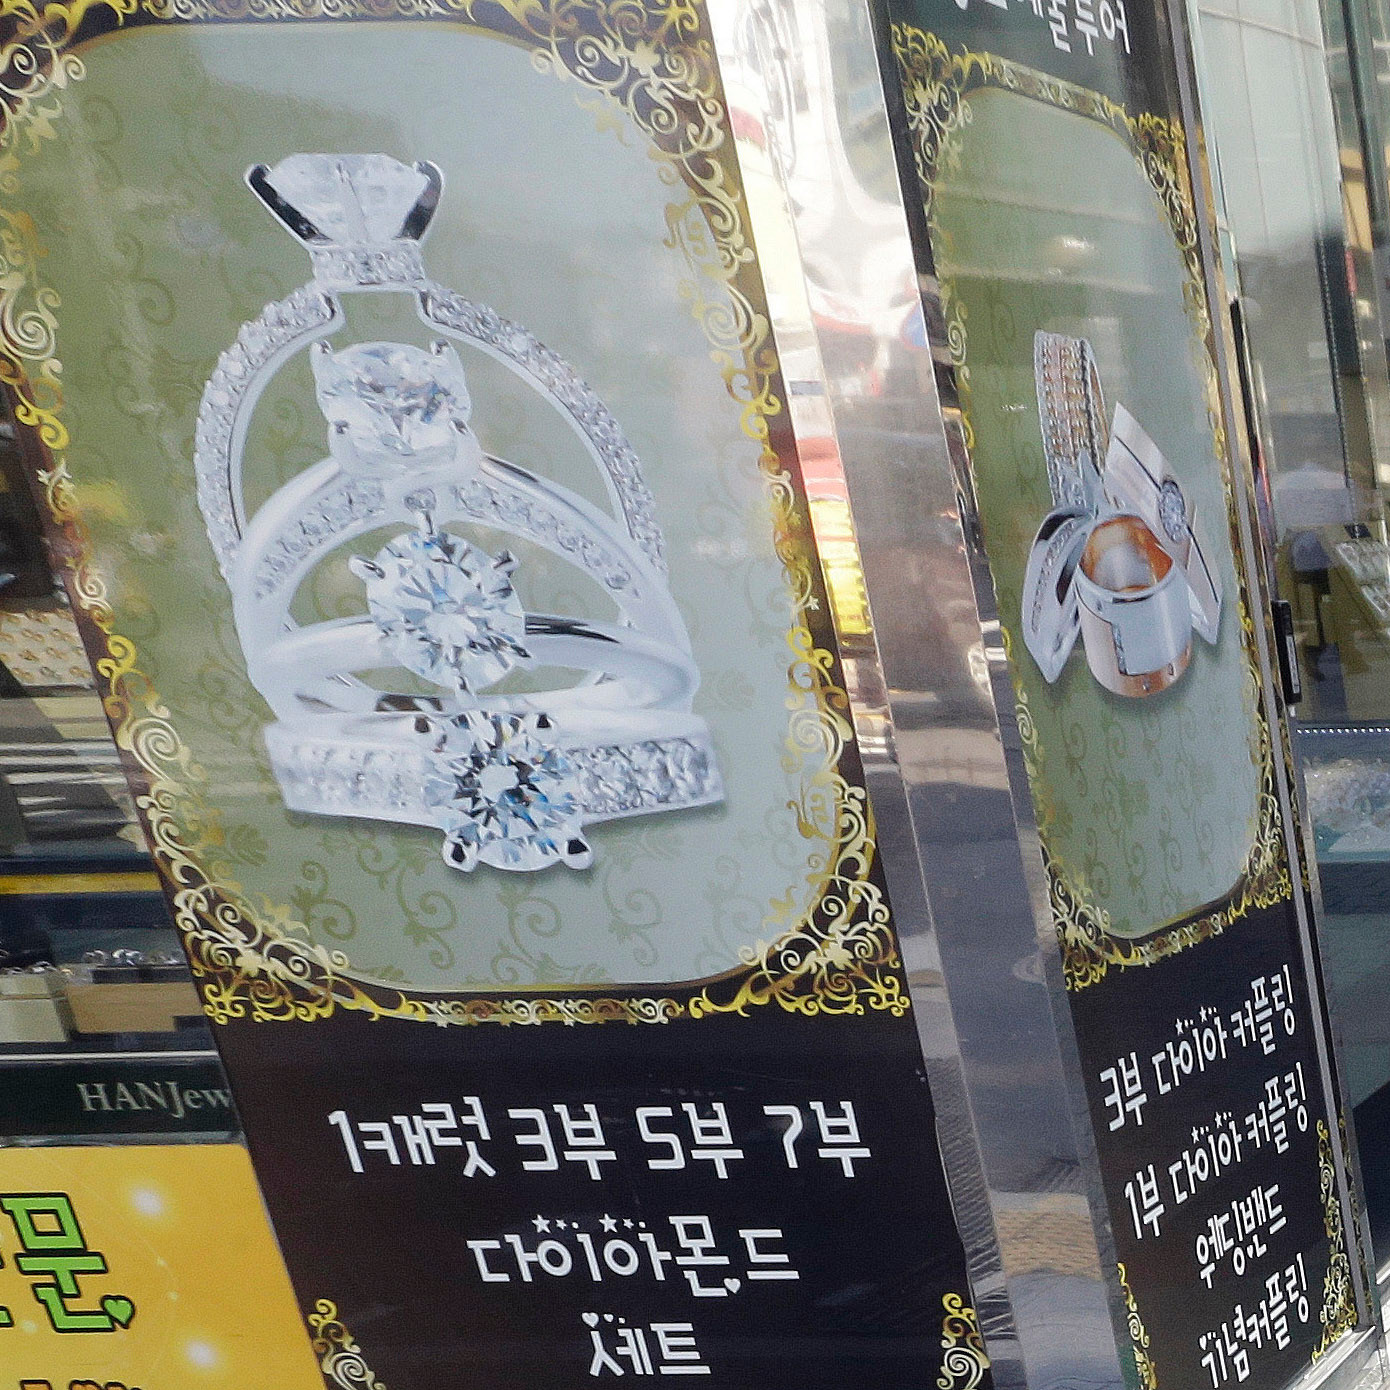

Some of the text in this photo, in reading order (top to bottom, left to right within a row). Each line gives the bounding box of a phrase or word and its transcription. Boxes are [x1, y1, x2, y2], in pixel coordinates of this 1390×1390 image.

[1099, 963, 1296, 1132] 3부 다이아 커플링
[328, 1095, 871, 1180] 1캐럿 3부 5부 7부
[1123, 1061, 1309, 1240] 1부 다이아 커플링
[0, 1192, 137, 1334] 문
[466, 1213, 800, 1298] 다이아몬드
[1195, 1183, 1288, 1289] 웨딩밴드
[580, 1311, 711, 1378] 세트
[1199, 1252, 1310, 1390] 기념커플링
